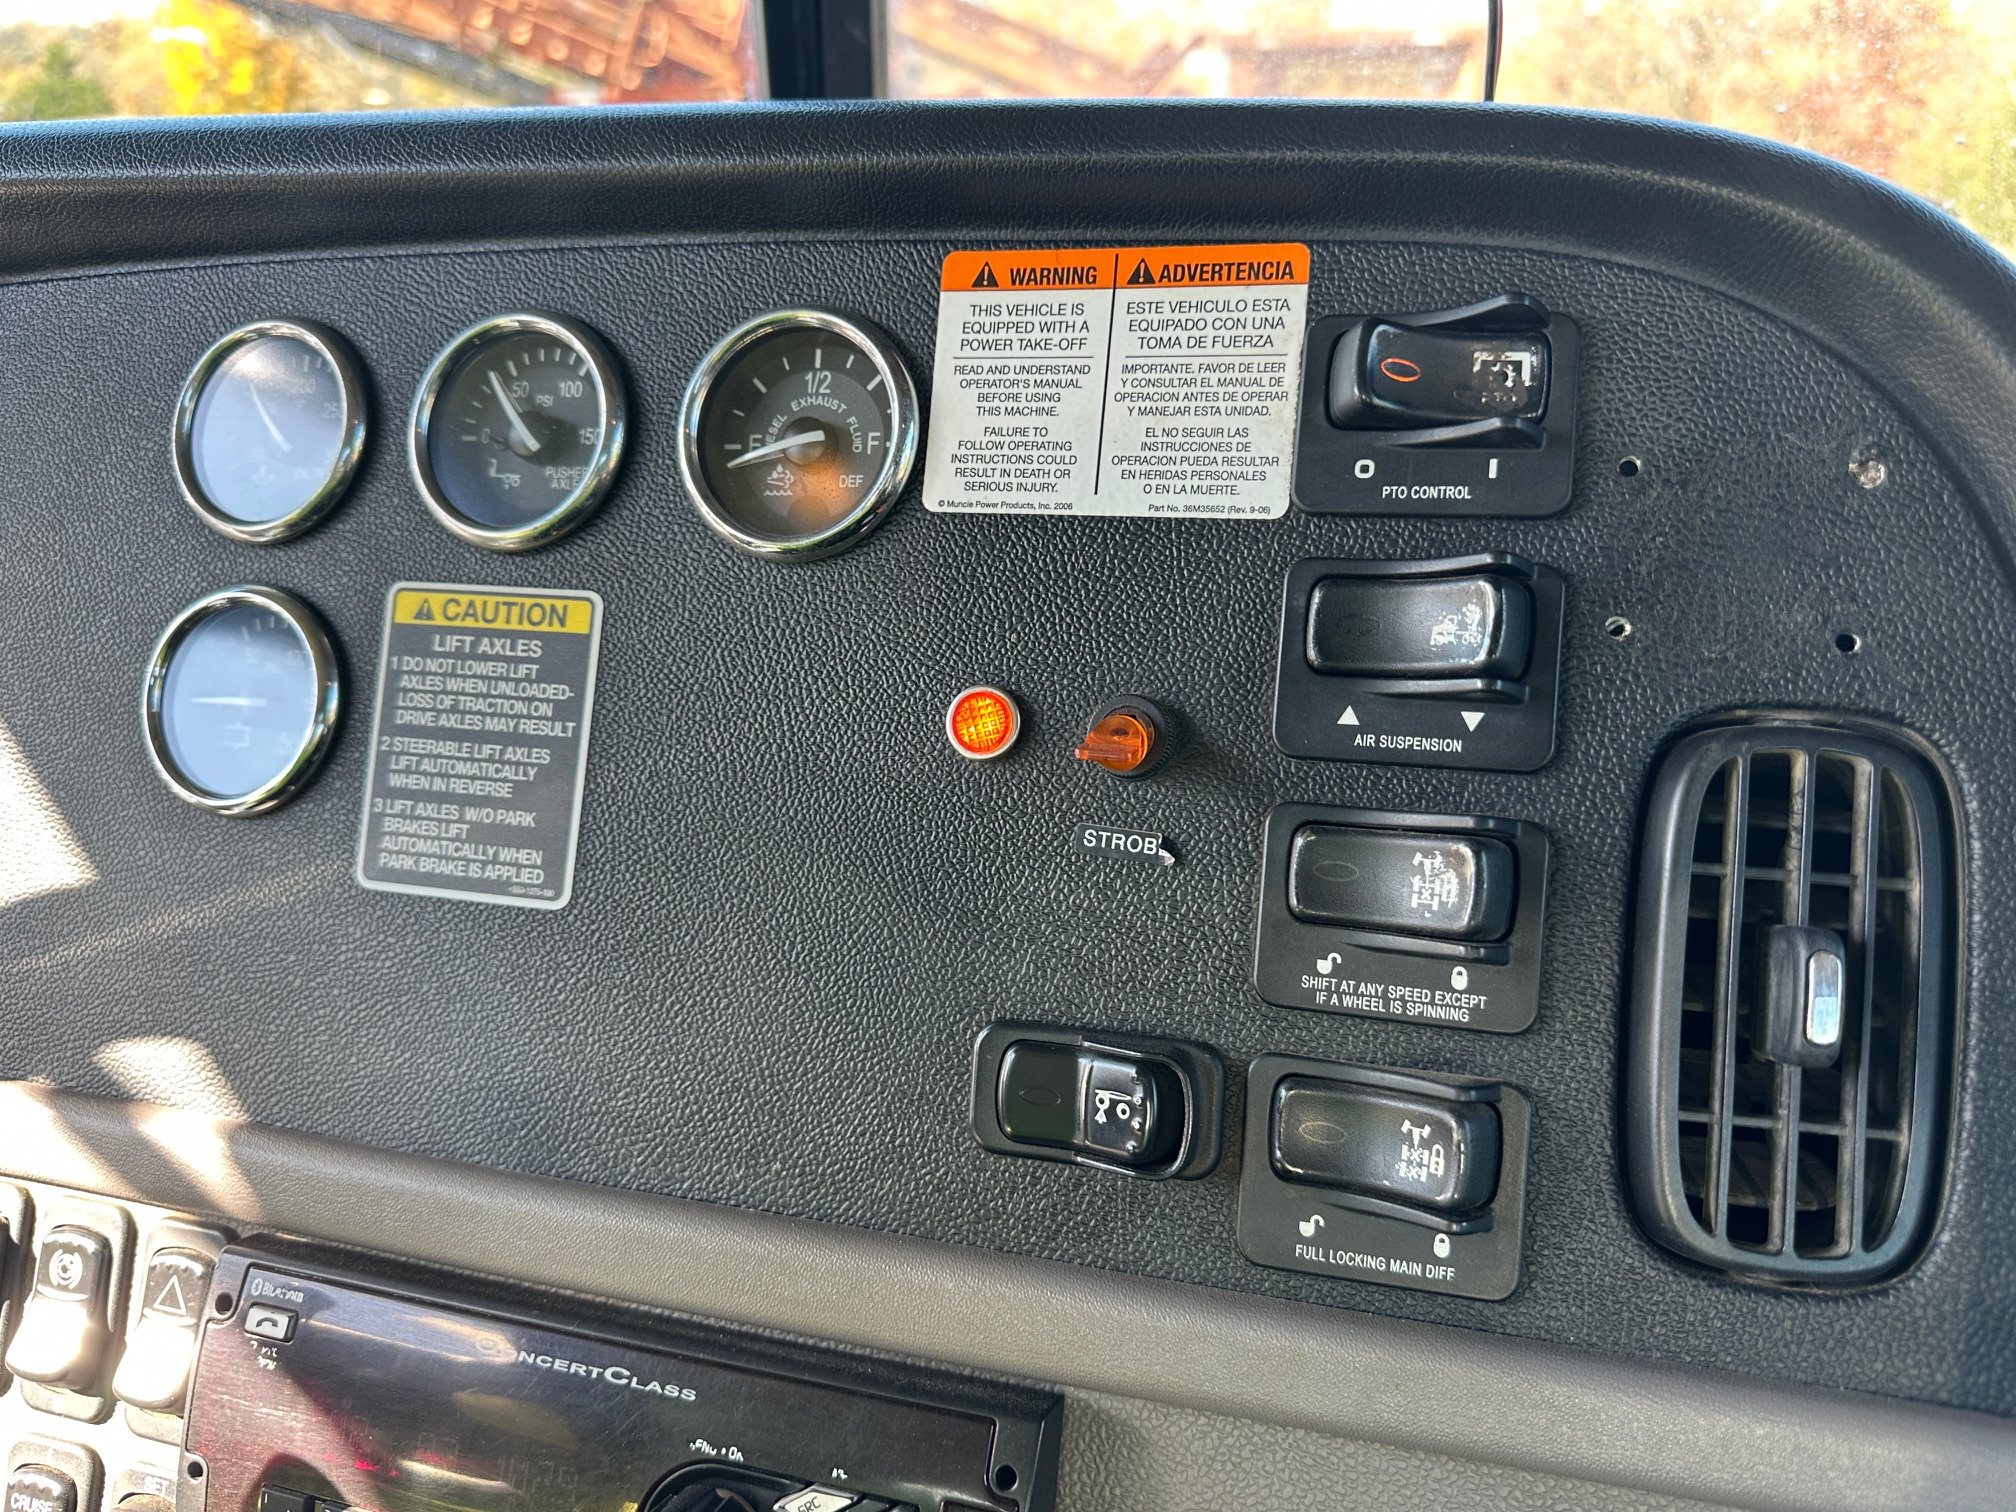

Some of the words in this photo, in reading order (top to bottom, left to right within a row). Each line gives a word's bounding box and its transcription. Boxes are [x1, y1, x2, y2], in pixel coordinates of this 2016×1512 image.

[1009, 266, 1097, 286] WARNING
[1158, 260, 1294, 283] ADVERTENCIA
[970, 304, 1002, 317] THIS
[1006, 303, 1067, 317] VEHICLE
[1071, 302, 1084, 316] IS
[1126, 301, 1165, 315] ESTE
[1168, 299, 1248, 314] VEHICULO
[1252, 298, 1291, 312] ESTA
[962, 321, 1035, 335] EQUIPPED
[1038, 320, 1076, 333] WITH
[1078, 320, 1090, 333] A
[1128, 317, 1207, 332] EQUIPADO
[1211, 317, 1247, 331] CON
[1252, 316, 1285, 330] UNA
[960, 338, 1013, 351] POWER
[1016, 337, 1088, 351] TAKE-OFF
[1137, 336, 1182, 350] TOMA
[1186, 335, 1208, 349] DE
[1211, 334, 1274, 348] FUERZA
[953, 364, 984, 375] READ
[986, 364, 1011, 375] AND
[1013, 364, 1091, 375] UNDERSTAND
[1121, 363, 1195, 374] IMPORTANTE.
[1198, 362, 1236, 374] FAVOR
[1238, 362, 1254, 373] DE
[1257, 362, 1286, 373] LEER
[513, 381, 530, 398] 50
[559, 381, 583, 398] 100
[805, 371, 832, 394] 1/2
[959, 378, 1030, 389] OPERATOR'S
[1033, 378, 1082, 389] MANUAL
[1120, 378, 1129, 388] Y
[1130, 377, 1197, 388] CONSULTAR
[1200, 377, 1214, 388] EL
[1216, 376, 1266, 388] MANUAL
[1268, 376, 1284, 387] DE
[536, 395, 553, 407] PSI
[977, 392, 1022, 403] BEFORE
[1025, 392, 1061, 403] USING
[1113, 391, 1180, 403] OPERACION
[1181, 391, 1220, 402] ANTES
[1222, 391, 1238, 402] DE
[1240, 390, 1289, 402] OPERAR
[790, 396, 847, 414] EXHAUST
[976, 405, 1001, 416] THIS
[1004, 406, 1059, 417] MACHINE.
[1127, 406, 1135, 416] Y
[1137, 405, 1191, 417] MANEJAR
[1194, 405, 1222, 416] ESTA
[1224, 405, 1271, 416] UNIDAD.
[846, 415, 862, 453] FLUID
[983, 426, 1030, 437] FAILURE
[1032, 426, 1048, 437] TO
[1145, 427, 1159, 438] EL
[1161, 427, 1179, 438] NO
[1181, 427, 1224, 438] SEGUIR
[1227, 427, 1249, 438] LAS
[867, 432, 881, 454] F
[958, 440, 1006, 451] FOLLOW
[1007, 440, 1072, 451] OPERATING
[1140, 441, 1233, 452] INSTRUCCIONES
[1236, 441, 1252, 452] DE
[950, 453, 1034, 465] INSTRUCTIONS
[1036, 454, 1078, 465] COULD
[1111, 455, 1177, 466] OPERACION
[1179, 455, 1219, 466] PUEDA
[1221, 456, 1279, 467] RESULTAR
[954, 467, 997, 478] RESULT
[999, 467, 1011, 478] IN
[1014, 468, 1051, 479] DEATH
[1053, 468, 1071, 479] OR
[1121, 469, 1136, 480] EN
[1138, 469, 1188, 481] HERIDAS
[1190, 470, 1266, 481] PERSONALES
[839, 475, 863, 488] DEF
[963, 480, 1013, 492] SERIOUS
[1016, 482, 1058, 493] INJURY.
[1143, 483, 1152, 494] O
[1155, 483, 1170, 494] EN
[1173, 484, 1187, 494] LA
[1190, 484, 1240, 496] MUERTE.
[1382, 486, 1408, 499] PTO
[1410, 485, 1472, 499] CONTROL
[946, 500, 974, 508] Muncie
[975, 500, 999, 509] Power
[1000, 500, 1036, 510] Products,
[1053, 502, 1073, 510] 2006
[1148, 503, 1165, 512] Part
[1182, 504, 1226, 513] 36M35652
[1249, 505, 1271, 516] 9-06)
[442, 598, 568, 628] CAUTION
[432, 634, 475, 653] LIFT
[477, 637, 542, 658] AXLES
[401, 656, 424, 672] DO
[425, 658, 456, 673] NOT
[456, 660, 508, 677] LOWER
[509, 663, 540, 679] LIFT
[399, 674, 444, 691] AXLES
[445, 677, 488, 694] WHEN
[397, 692, 434, 708] LOSS
[436, 694, 457, 709] OF
[457, 695, 528, 715] TRACTION
[530, 701, 553, 717] ON
[395, 709, 437, 726] DRIVE
[437, 712, 483, 730] AXLES
[484, 716, 518, 732] MAY
[518, 718, 576, 737] RESULT
[392, 736, 472, 757] STEERABLE
[473, 743, 503, 760] LIFT
[503, 746, 550, 764] AXLES
[1353, 733, 1375, 747] AIR
[1379, 734, 1462, 753] SUSPENSION
[390, 755, 420, 770] LIFT
[419, 757, 538, 781] AUTOMATICALLY
[389, 772, 431, 790] WHEN
[432, 776, 447, 792] IN
[448, 777, 514, 798] REVERSE
[385, 799, 414, 815] LIFT
[414, 802, 459, 820] AXLES
[465, 806, 494, 823] W/O
[496, 809, 537, 827] PARK
[382, 816, 439, 836] BRAKES
[440, 822, 470, 839] LIFT
[379, 835, 497, 860] AUTOMATICALLY
[499, 846, 542, 865] WHEN
[378, 852, 417, 871] PARK
[418, 856, 467, 876] BRAKE
[468, 862, 482, 878] IS
[483, 864, 544, 884] APPLIED
[1301, 974, 1338, 991] SHIFT
[1339, 979, 1356, 993] AT
[1357, 981, 1385, 996] ANY
[1387, 985, 1431, 1002] SPEED
[1434, 990, 1487, 1009] EXCEPT
[1316, 991, 1328, 1004] IF
[1330, 993, 1339, 1006] A
[1342, 994, 1386, 1012] WHEEL
[1389, 1000, 1402, 1014] IS
[1406, 1001, 1469, 1022] SPINNING
[1295, 1244, 1325, 1262] FULL
[1329, 1249, 1386, 1271] LOCKING
[1389, 1258, 1422, 1276] MAIN
[1425, 1264, 1455, 1280] DIFF
